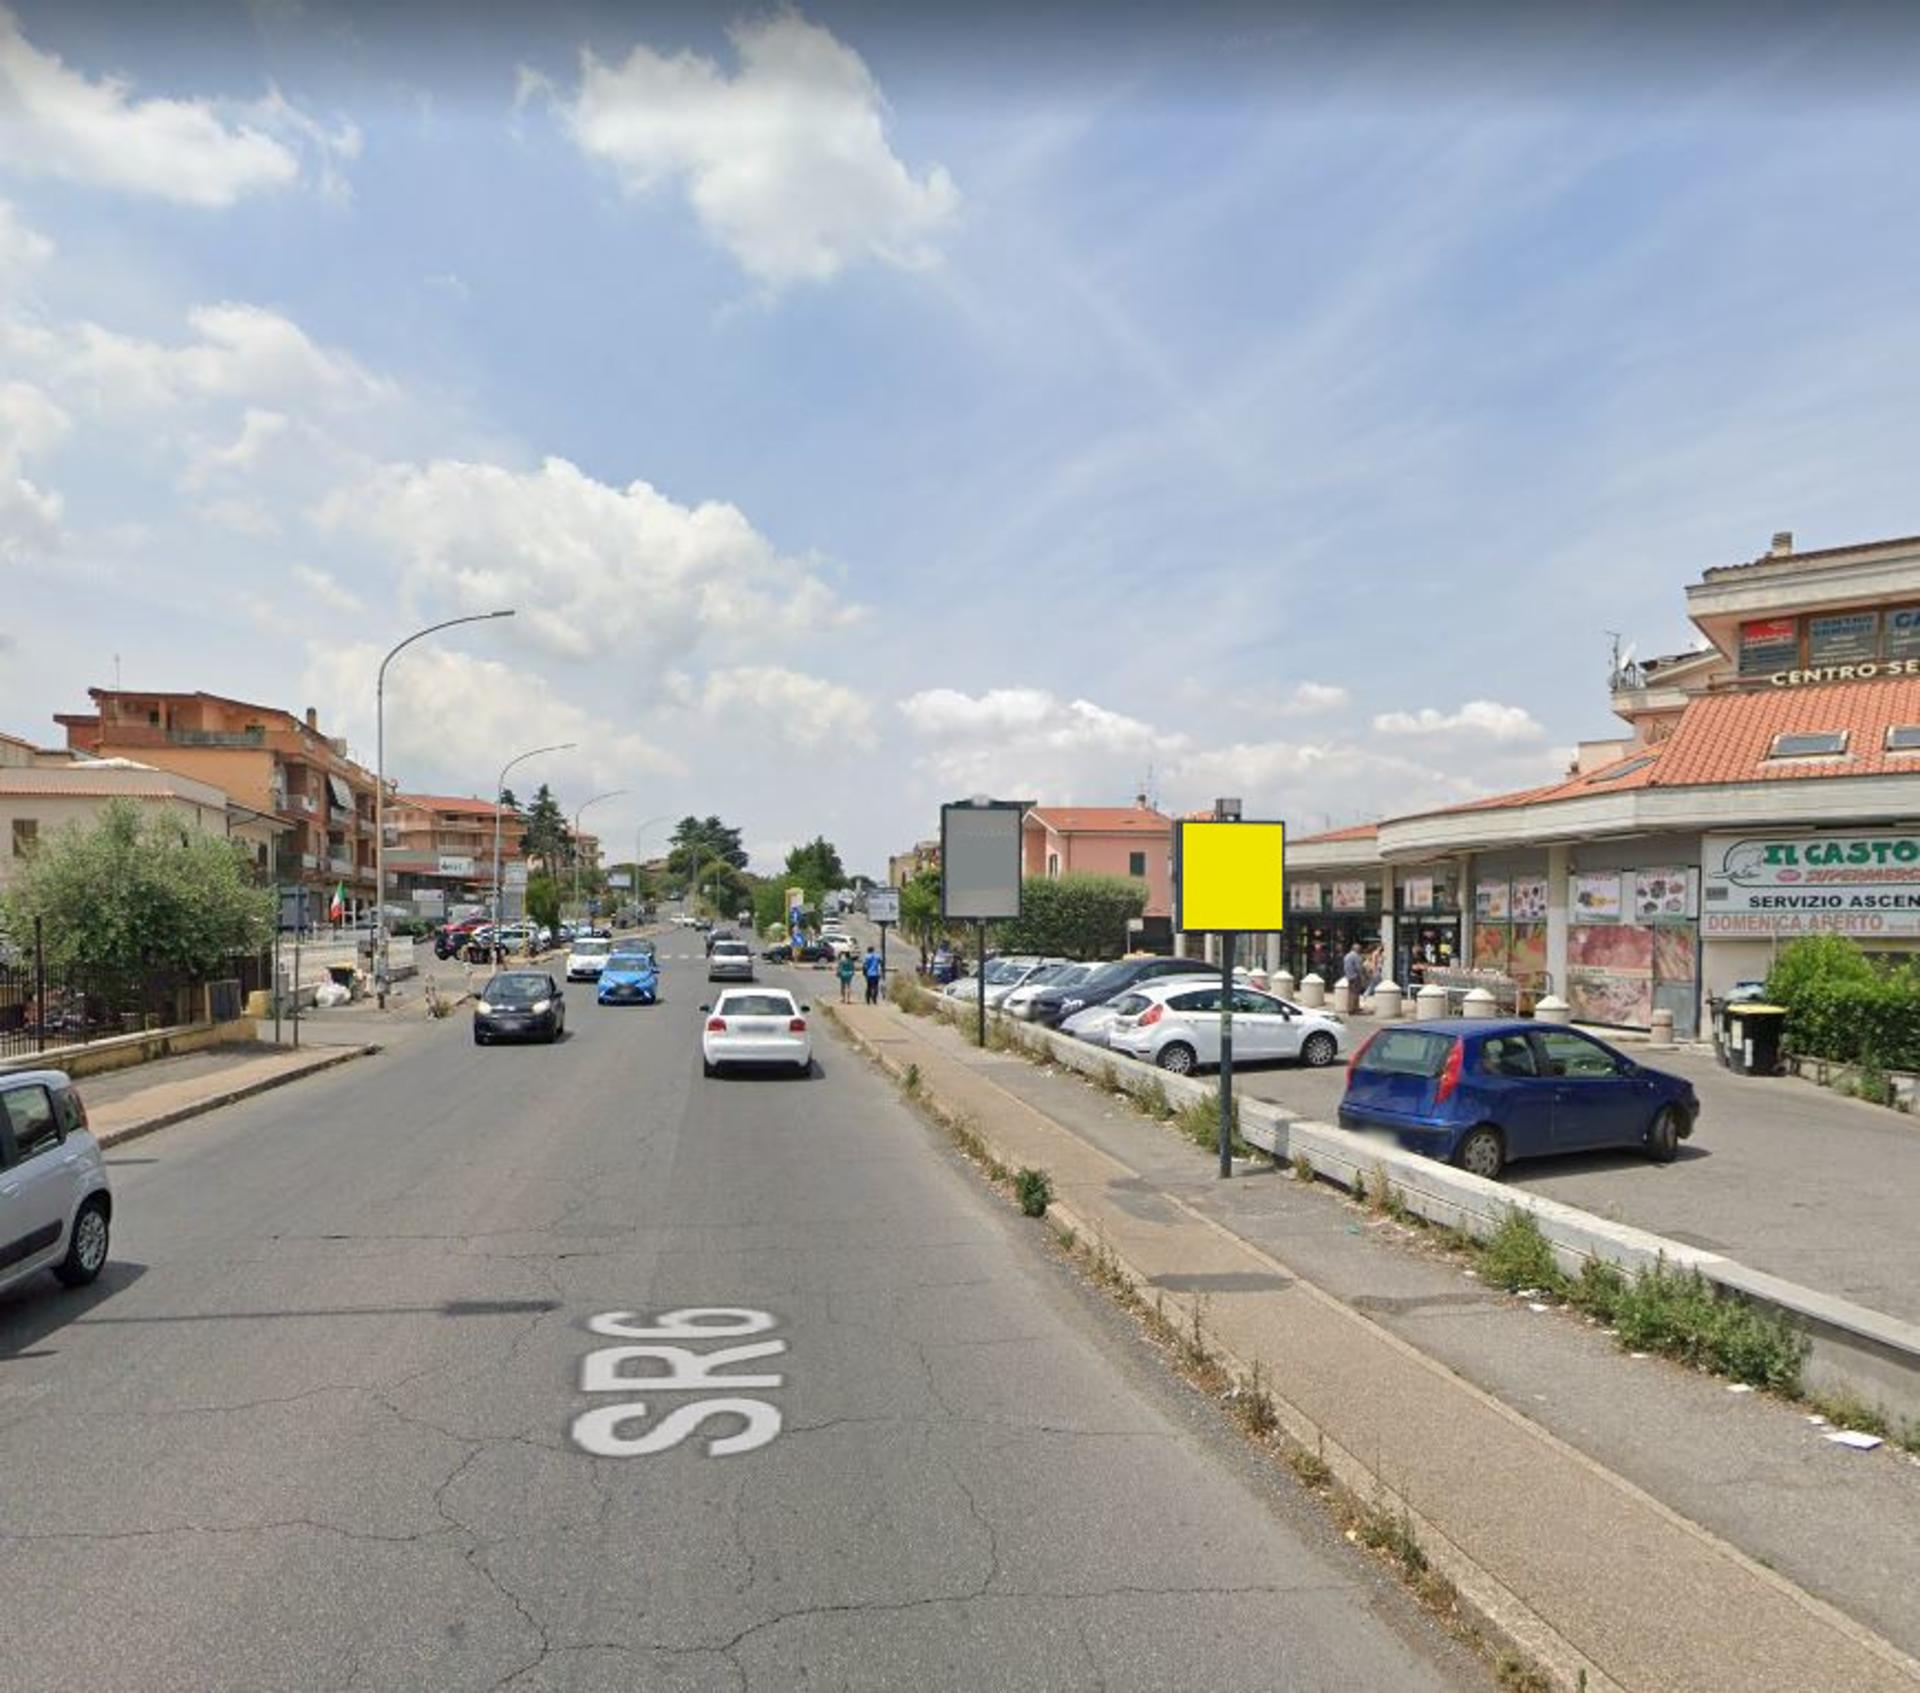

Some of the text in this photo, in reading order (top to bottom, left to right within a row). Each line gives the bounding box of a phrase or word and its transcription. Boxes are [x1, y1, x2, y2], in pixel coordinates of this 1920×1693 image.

[1771, 663, 1877, 686] CENTRO
[1763, 840, 1920, 866] IL CASTO
[1749, 894, 1920, 908] SERVIZIO ASCEN
[1708, 914, 1801, 931] DOMENICA
